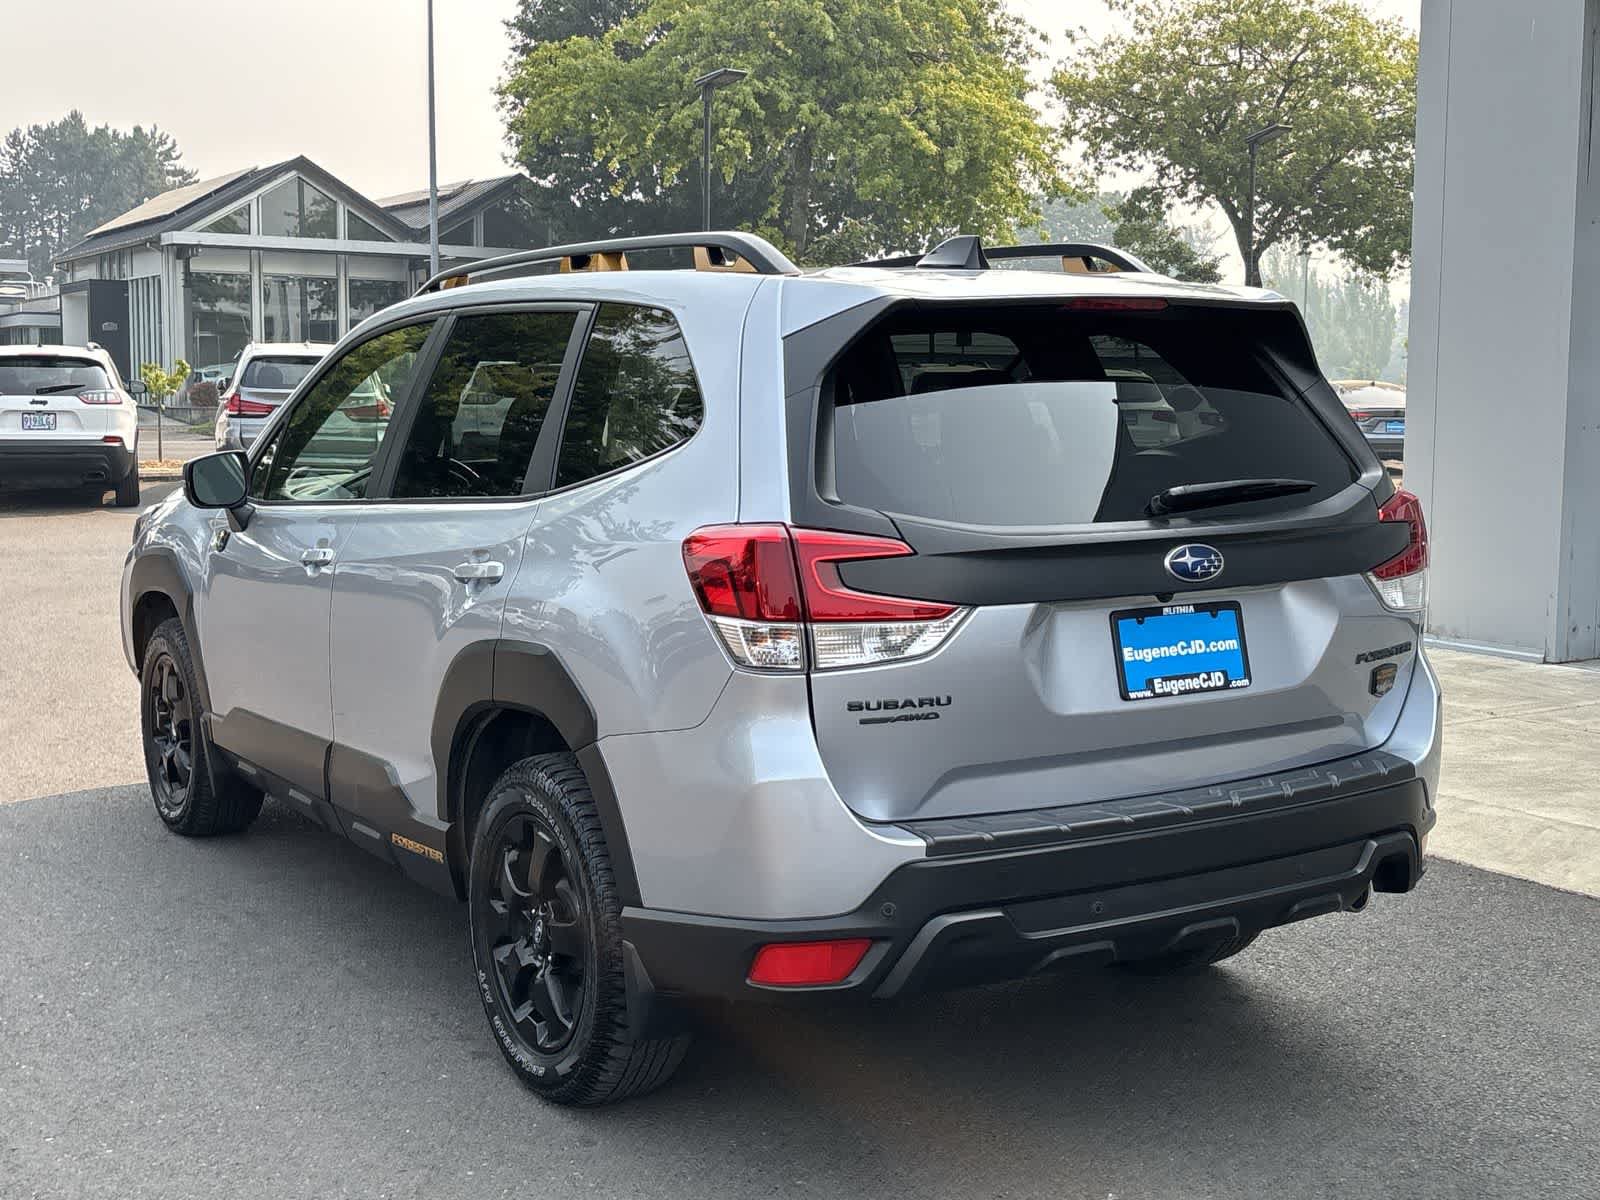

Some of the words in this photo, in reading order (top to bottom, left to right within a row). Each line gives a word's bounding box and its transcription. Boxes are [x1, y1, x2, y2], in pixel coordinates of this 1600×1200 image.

[1122, 639, 1238, 662] EugeneCJD.com
[1153, 671, 1225, 695] EugeneCJD
[847, 696, 952, 712] SUBARU
[391, 832, 444, 865] FORESTER
